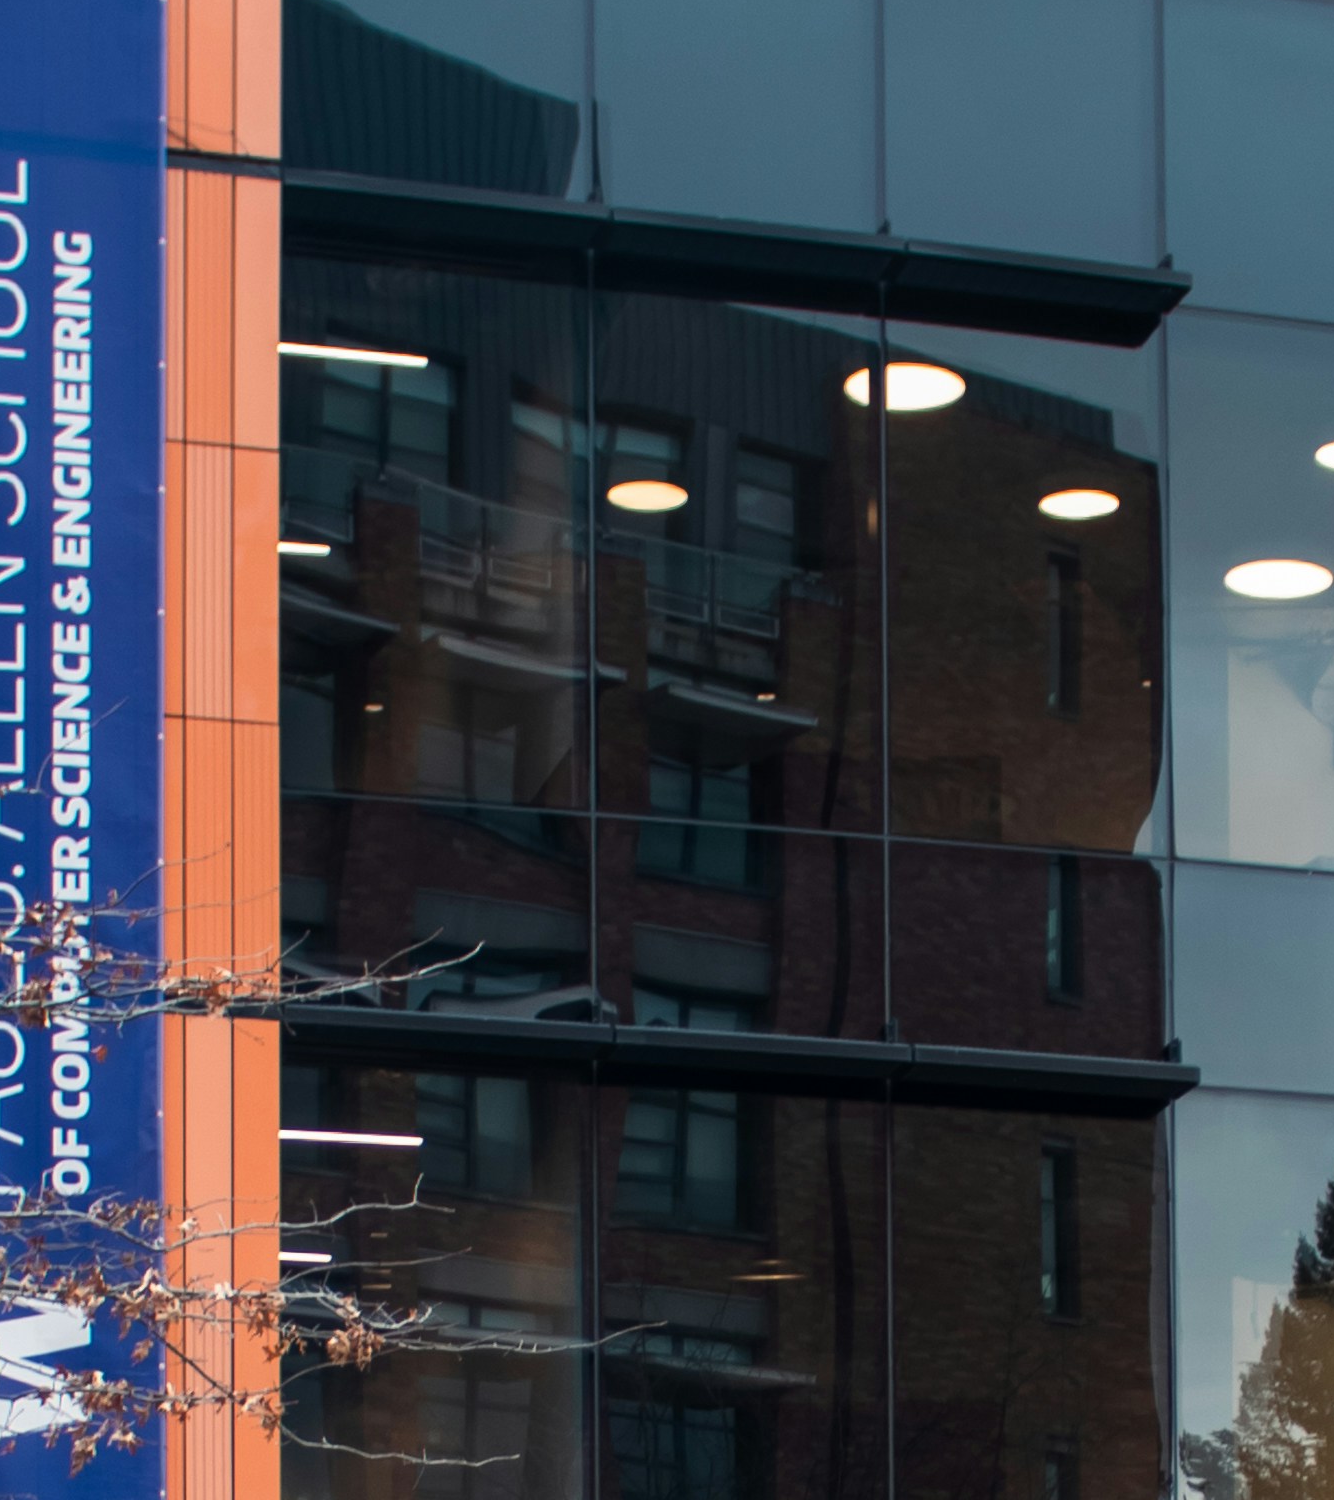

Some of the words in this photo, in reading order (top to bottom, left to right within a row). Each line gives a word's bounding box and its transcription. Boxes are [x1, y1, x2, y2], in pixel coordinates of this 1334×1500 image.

[52, 231, 93, 568] ENGINEERING
[52, 575, 91, 615] &
[51, 622, 91, 829] SCIENCE
[51, 1128, 91, 1196] OF
